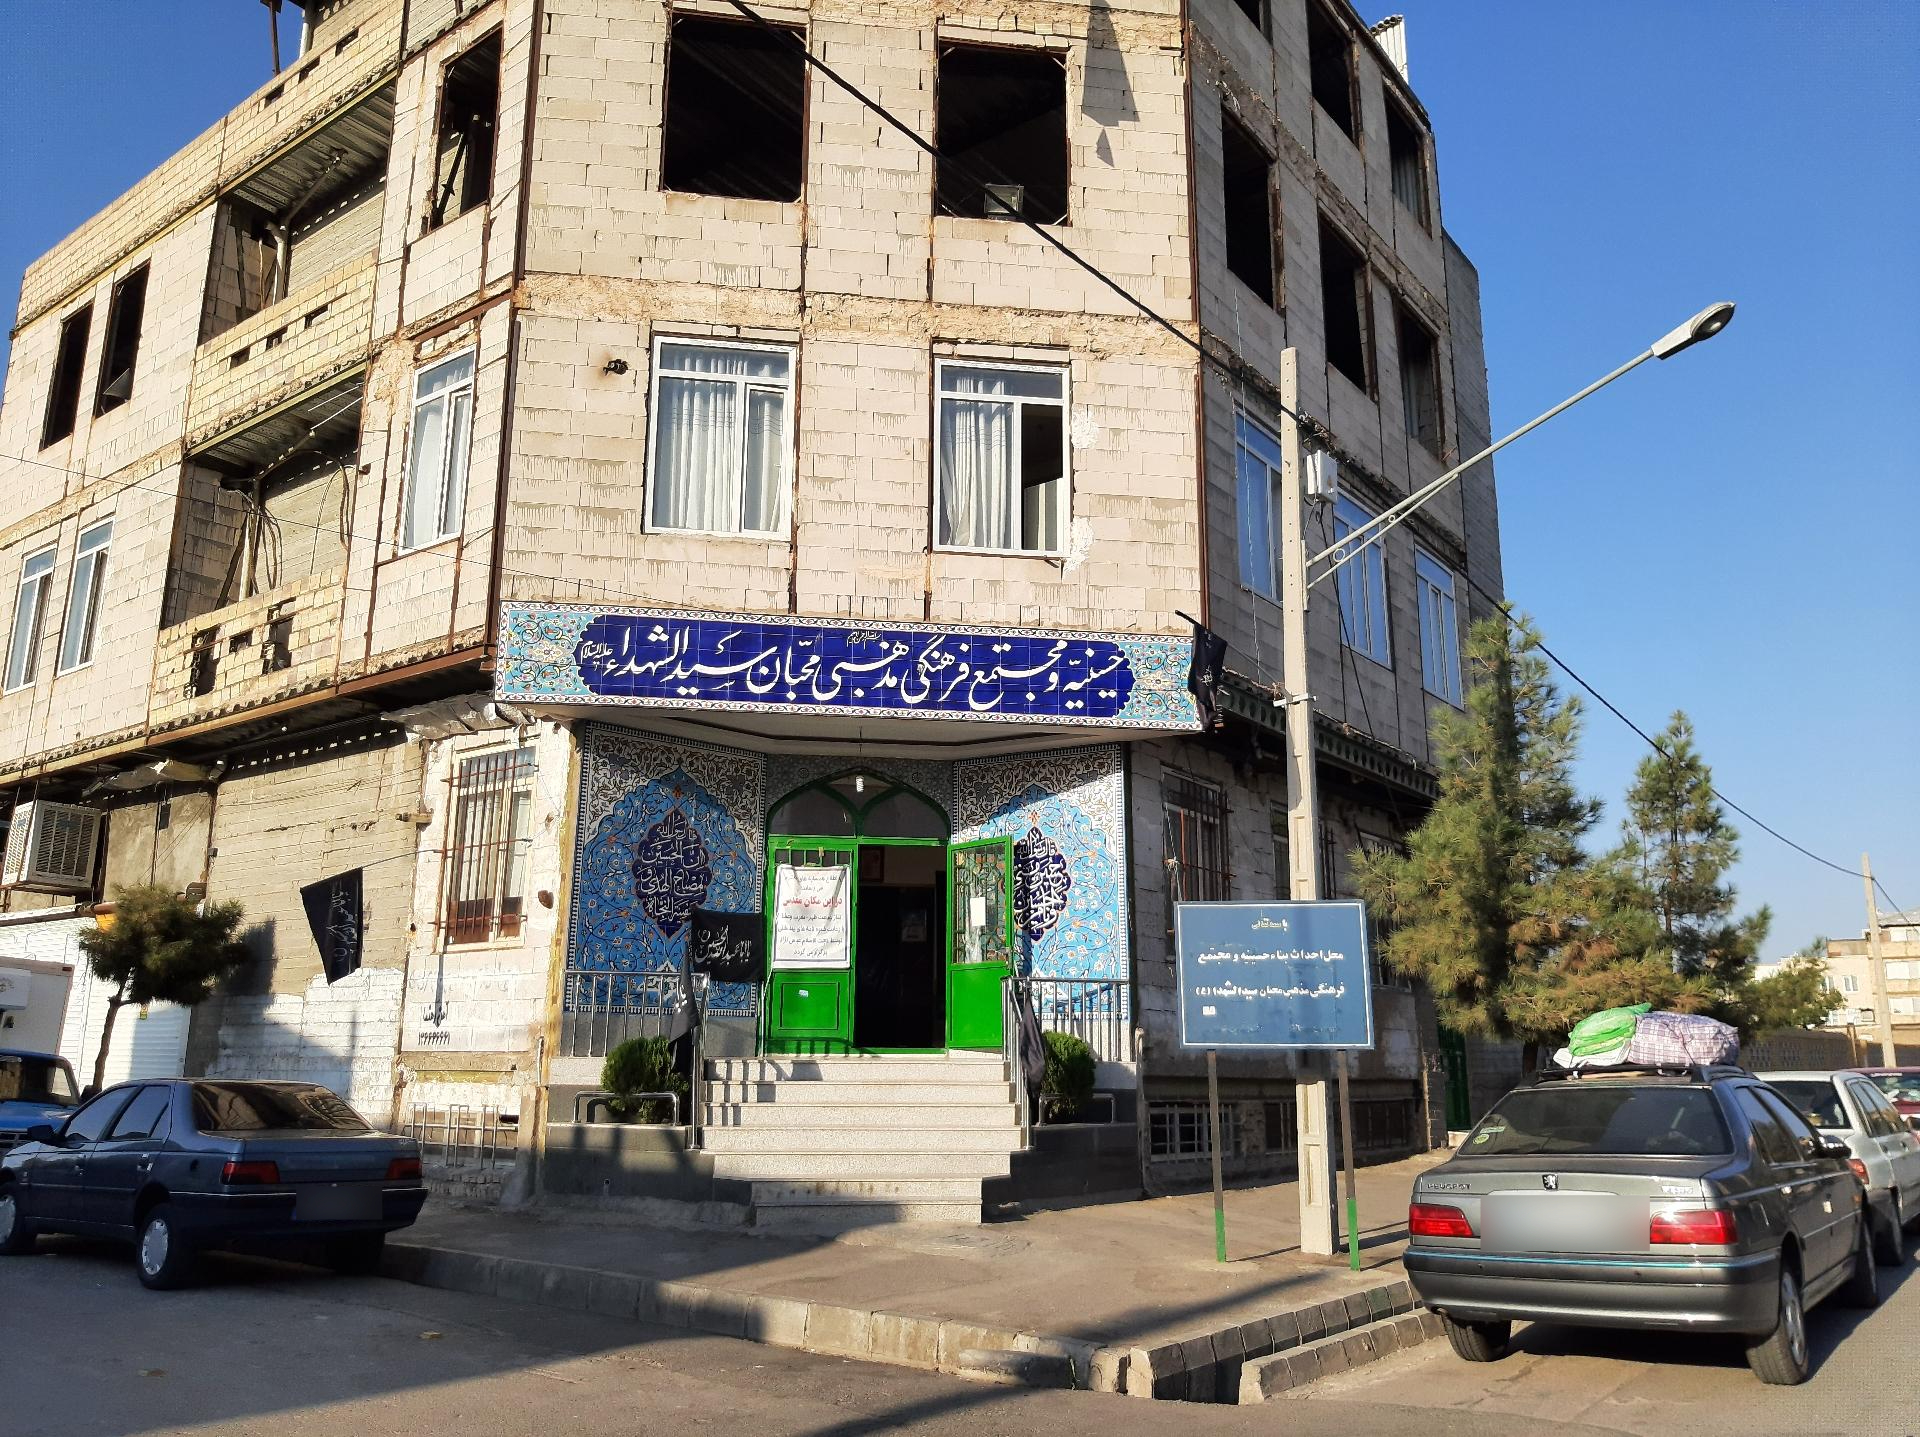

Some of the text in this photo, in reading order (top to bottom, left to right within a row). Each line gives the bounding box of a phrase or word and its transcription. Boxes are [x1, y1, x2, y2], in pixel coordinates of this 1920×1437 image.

[747, 641, 821, 701] محبان
[812, 640, 910, 701] مذهبی
[901, 634, 971, 704] فرهنگی
[968, 640, 1069, 711] مجتمع
[1043, 671, 1059, 693] و
[1197, 947, 1232, 965] مجتمع
[1232, 954, 1239, 963] و
[1241, 949, 1270, 965] حسینیه
[1291, 948, 1323, 961] احداث
[1324, 949, 1344, 962] محل
[1284, 982, 1310, 1000] مذهبی
[1309, 981, 1346, 999] فرهنگی
